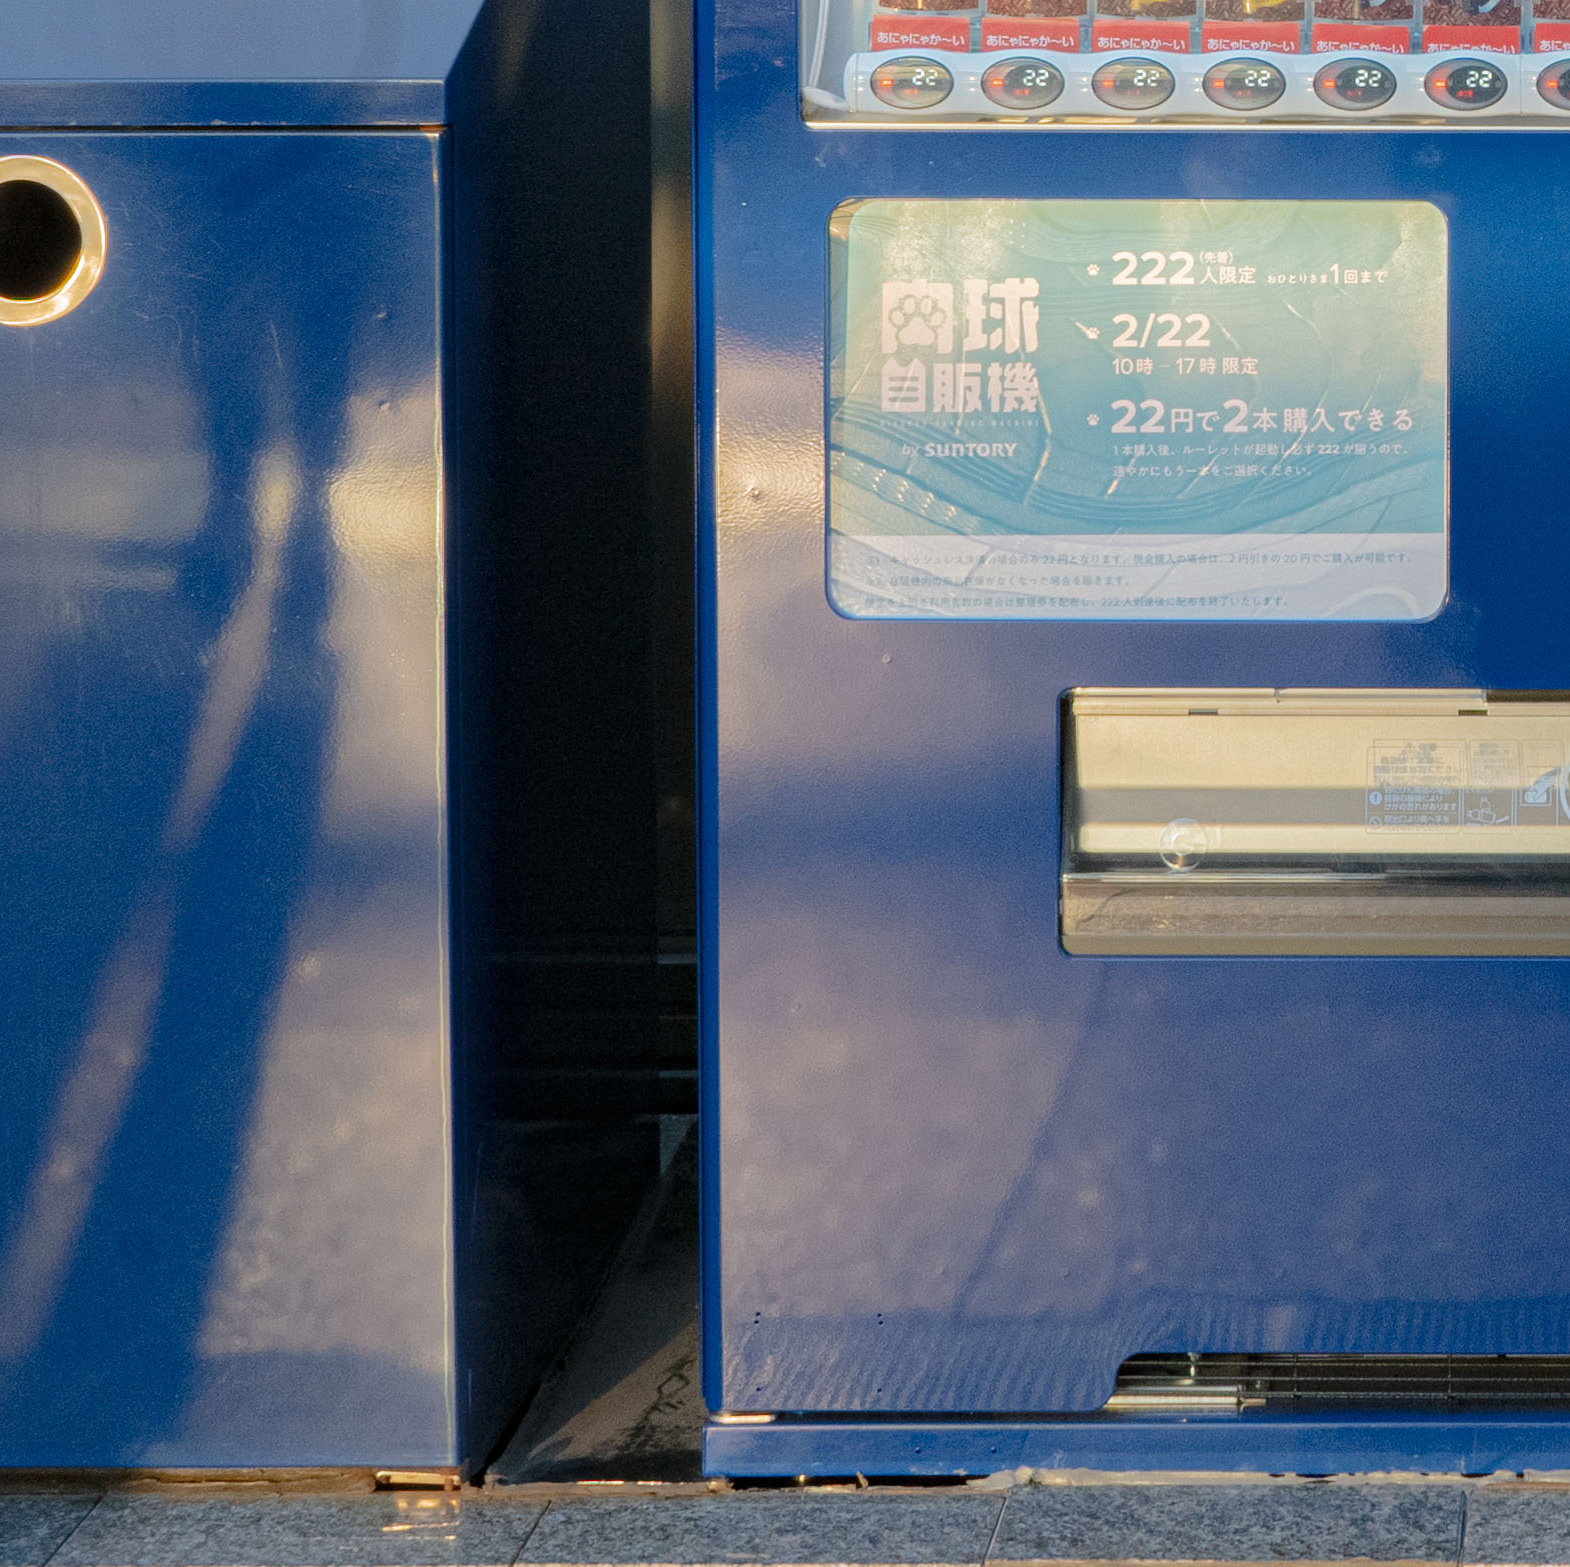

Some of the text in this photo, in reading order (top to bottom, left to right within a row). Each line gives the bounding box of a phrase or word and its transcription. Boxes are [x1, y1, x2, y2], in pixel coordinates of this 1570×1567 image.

[1023, 69, 1048, 86] 22
[1112, 313, 1211, 348] 2/22
[882, 358, 1039, 412] 自販機
[1111, 399, 1413, 433] 22円で2本購入できる
[925, 443, 1017, 457] SUNTORY
